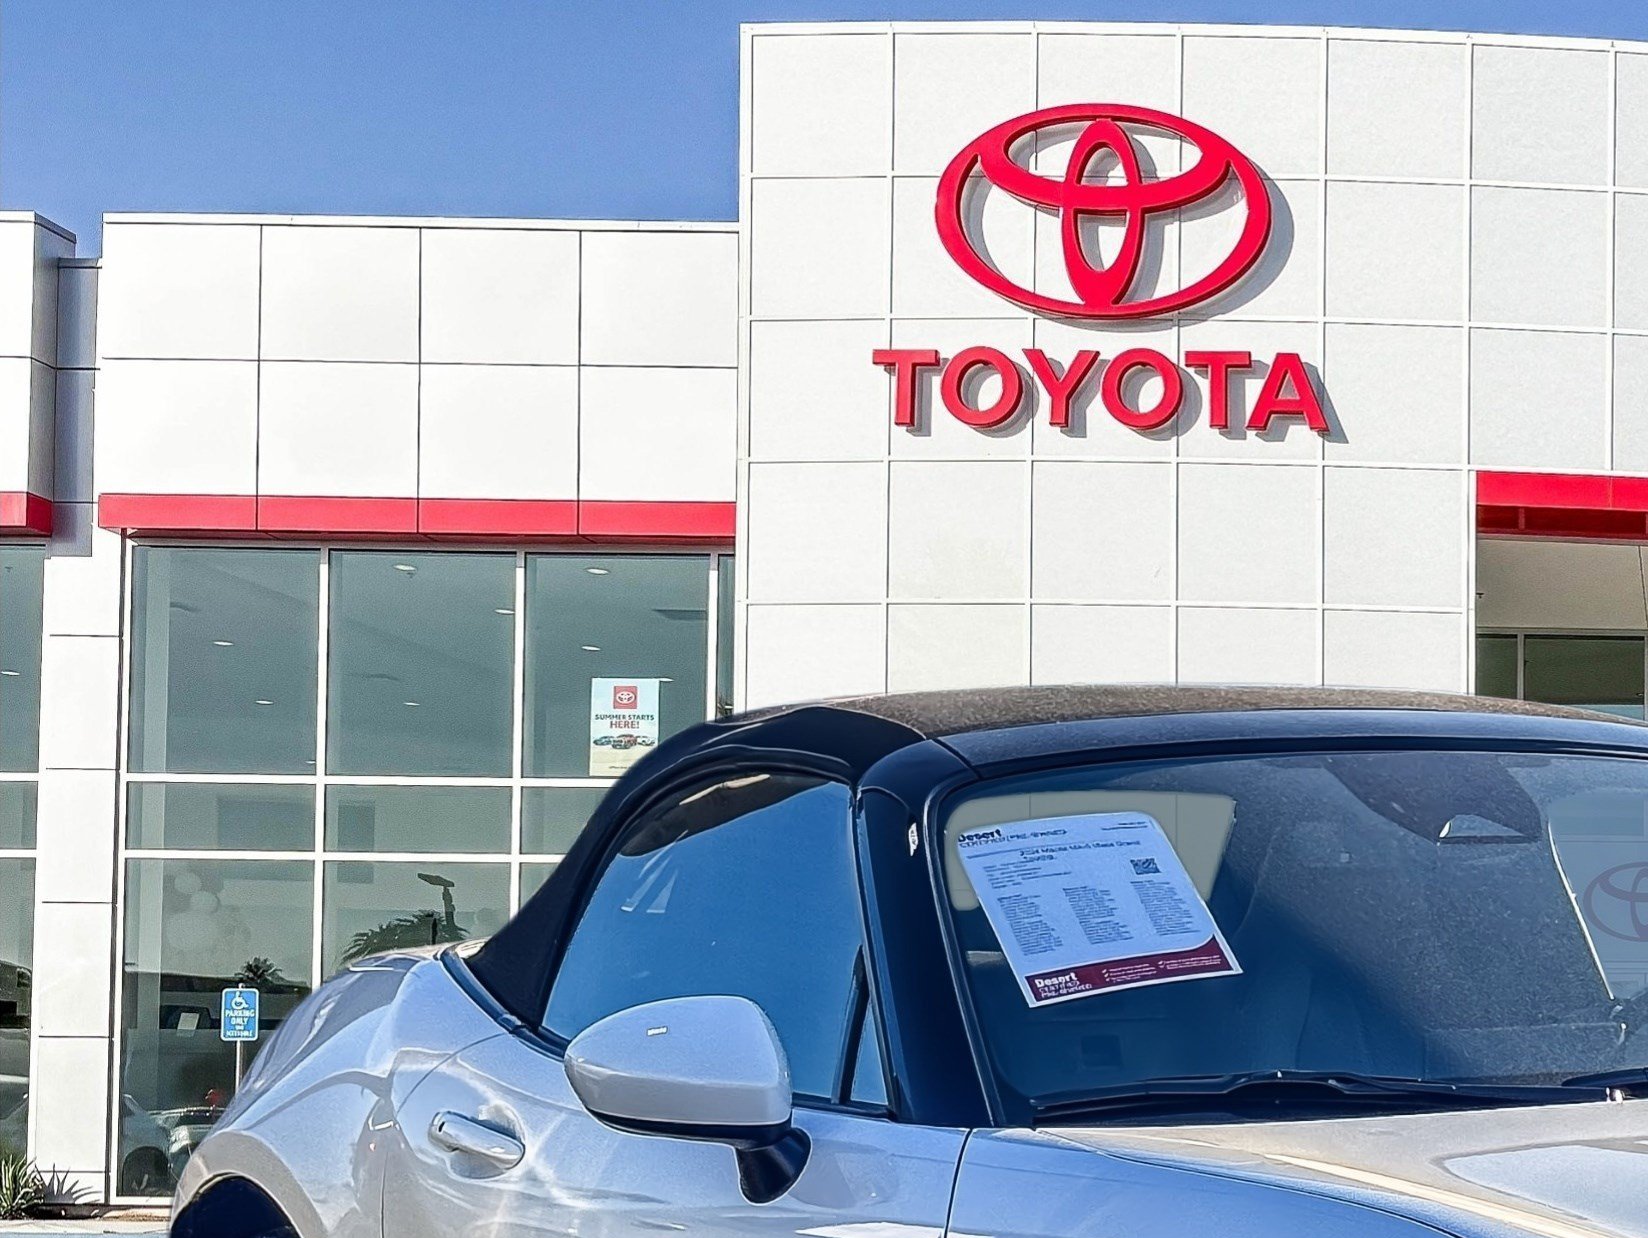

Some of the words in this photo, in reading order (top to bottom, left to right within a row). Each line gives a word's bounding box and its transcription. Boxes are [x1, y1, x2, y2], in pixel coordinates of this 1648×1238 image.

[872, 346, 1329, 432] TOYOTA
[610, 721, 640, 729] HERE!
[958, 829, 1002, 842] Desert
[1035, 972, 1077, 988] Desert
[230, 1017, 249, 1025] ONLY
